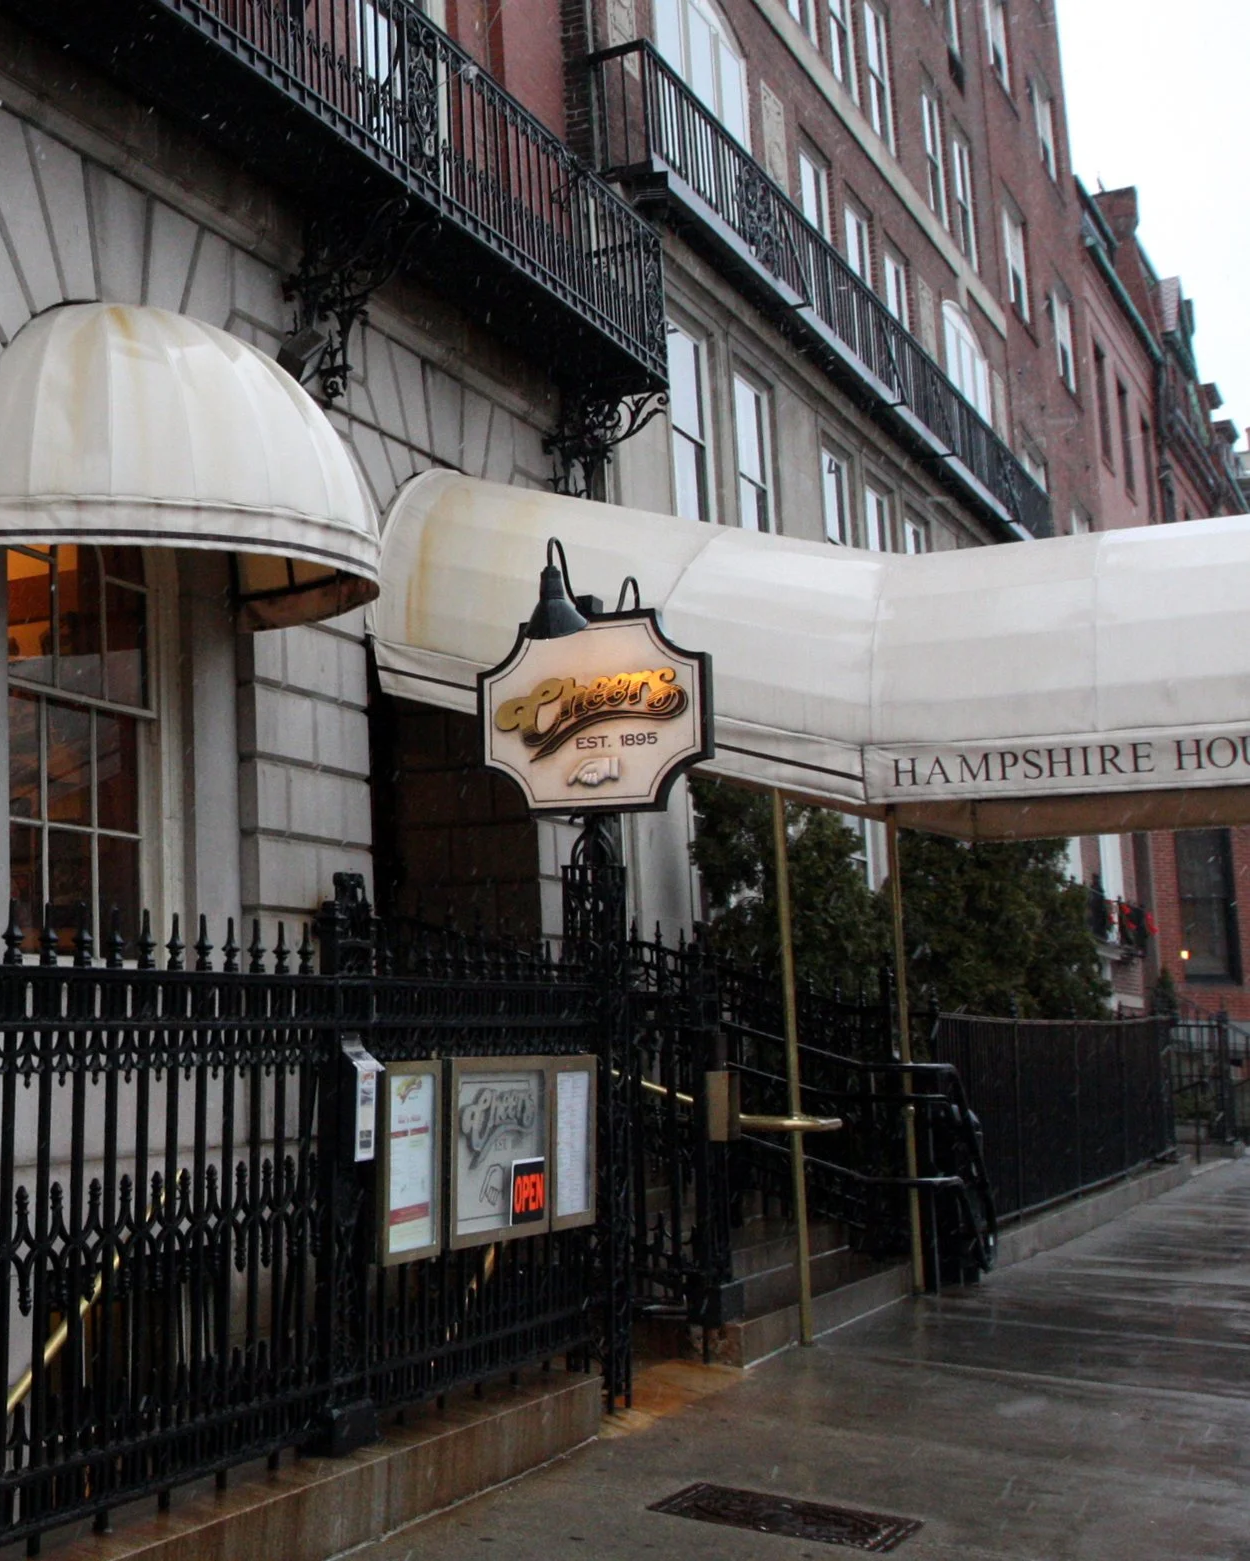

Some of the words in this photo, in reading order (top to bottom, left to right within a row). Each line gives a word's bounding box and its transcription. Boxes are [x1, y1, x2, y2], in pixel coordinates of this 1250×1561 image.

[495, 667, 688, 757] Cheers
[575, 735, 612, 750] EST.
[619, 731, 658, 747] 1895
[892, 741, 1155, 787] HAMPSHIRE
[514, 1173, 545, 1214] OPEN
